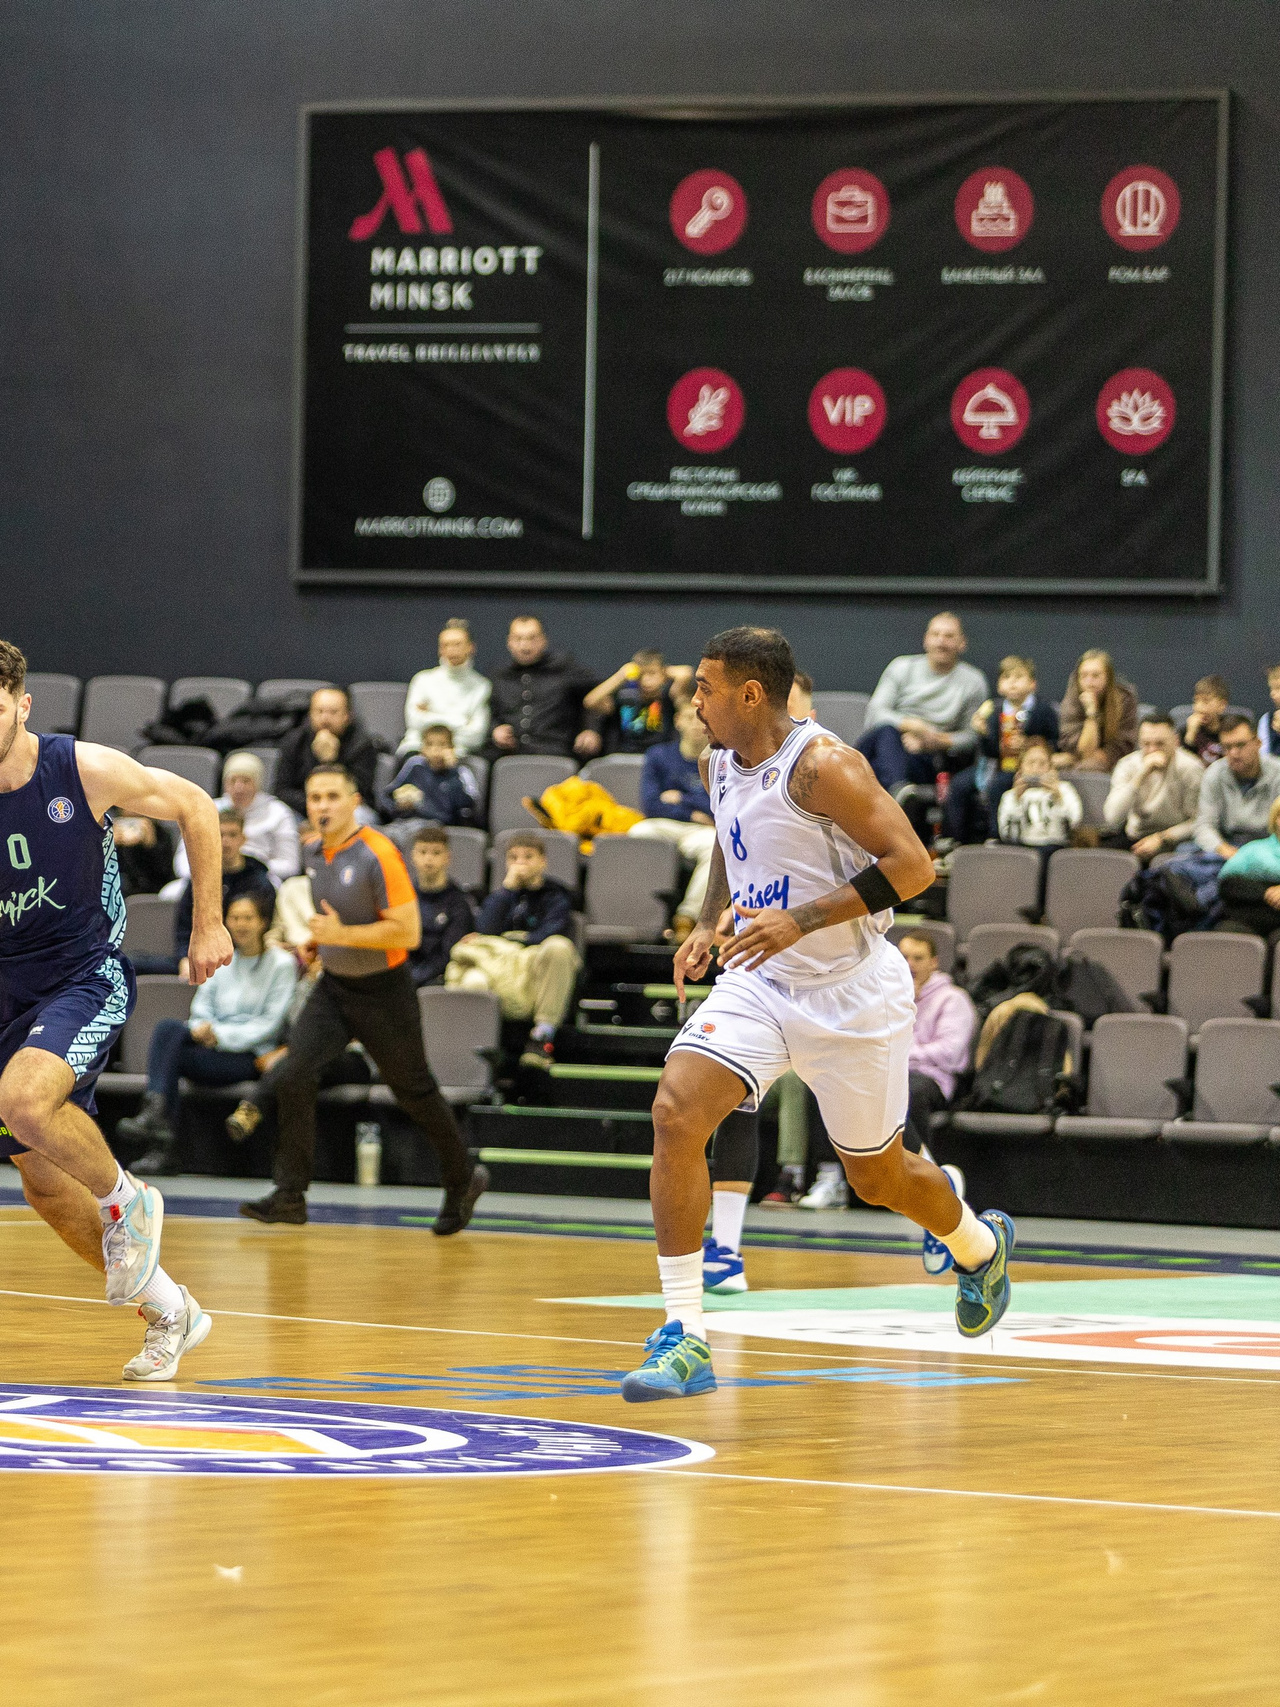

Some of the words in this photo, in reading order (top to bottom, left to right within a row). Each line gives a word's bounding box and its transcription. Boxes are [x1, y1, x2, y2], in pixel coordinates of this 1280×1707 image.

[370, 245, 544, 276] MARRIOTT
[369, 280, 475, 312] MINSK
[342, 342, 413, 363] TRAVEL
[822, 395, 877, 427] VIP
[6, 833, 32, 870] 0
[729, 816, 748, 862] 8
[732, 874, 790, 927] Eisey
